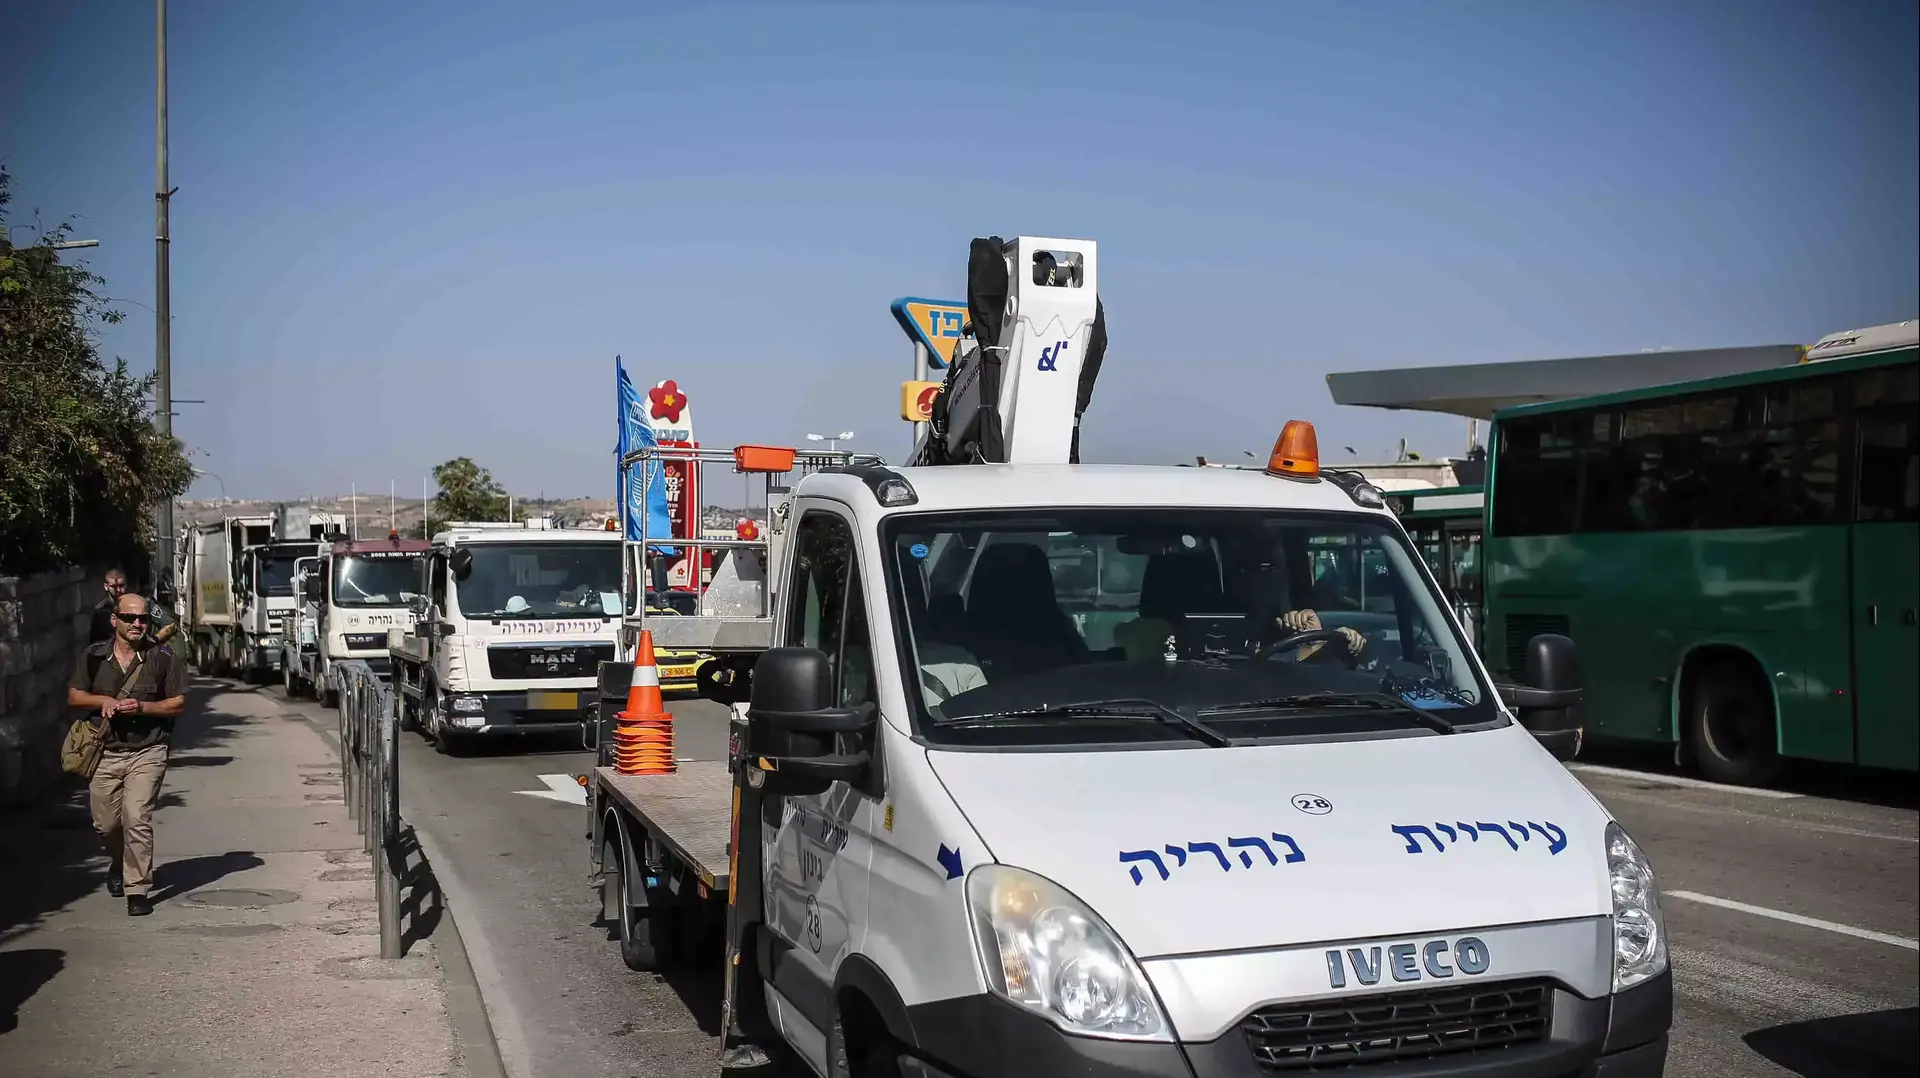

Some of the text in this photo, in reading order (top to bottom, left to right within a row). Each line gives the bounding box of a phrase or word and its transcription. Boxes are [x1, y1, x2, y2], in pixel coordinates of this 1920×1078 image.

[929, 310, 963, 337] פז
[368, 615, 392, 625] נהריה
[502, 621, 602, 635] עיריית נהריה
[530, 653, 576, 664] MAN
[1298, 797, 1329, 810] 28
[803, 848, 823, 884] גינון
[1119, 819, 1569, 886] עיריית נהריה
[807, 909, 820, 939] 28
[1325, 936, 1492, 989] IVECO
